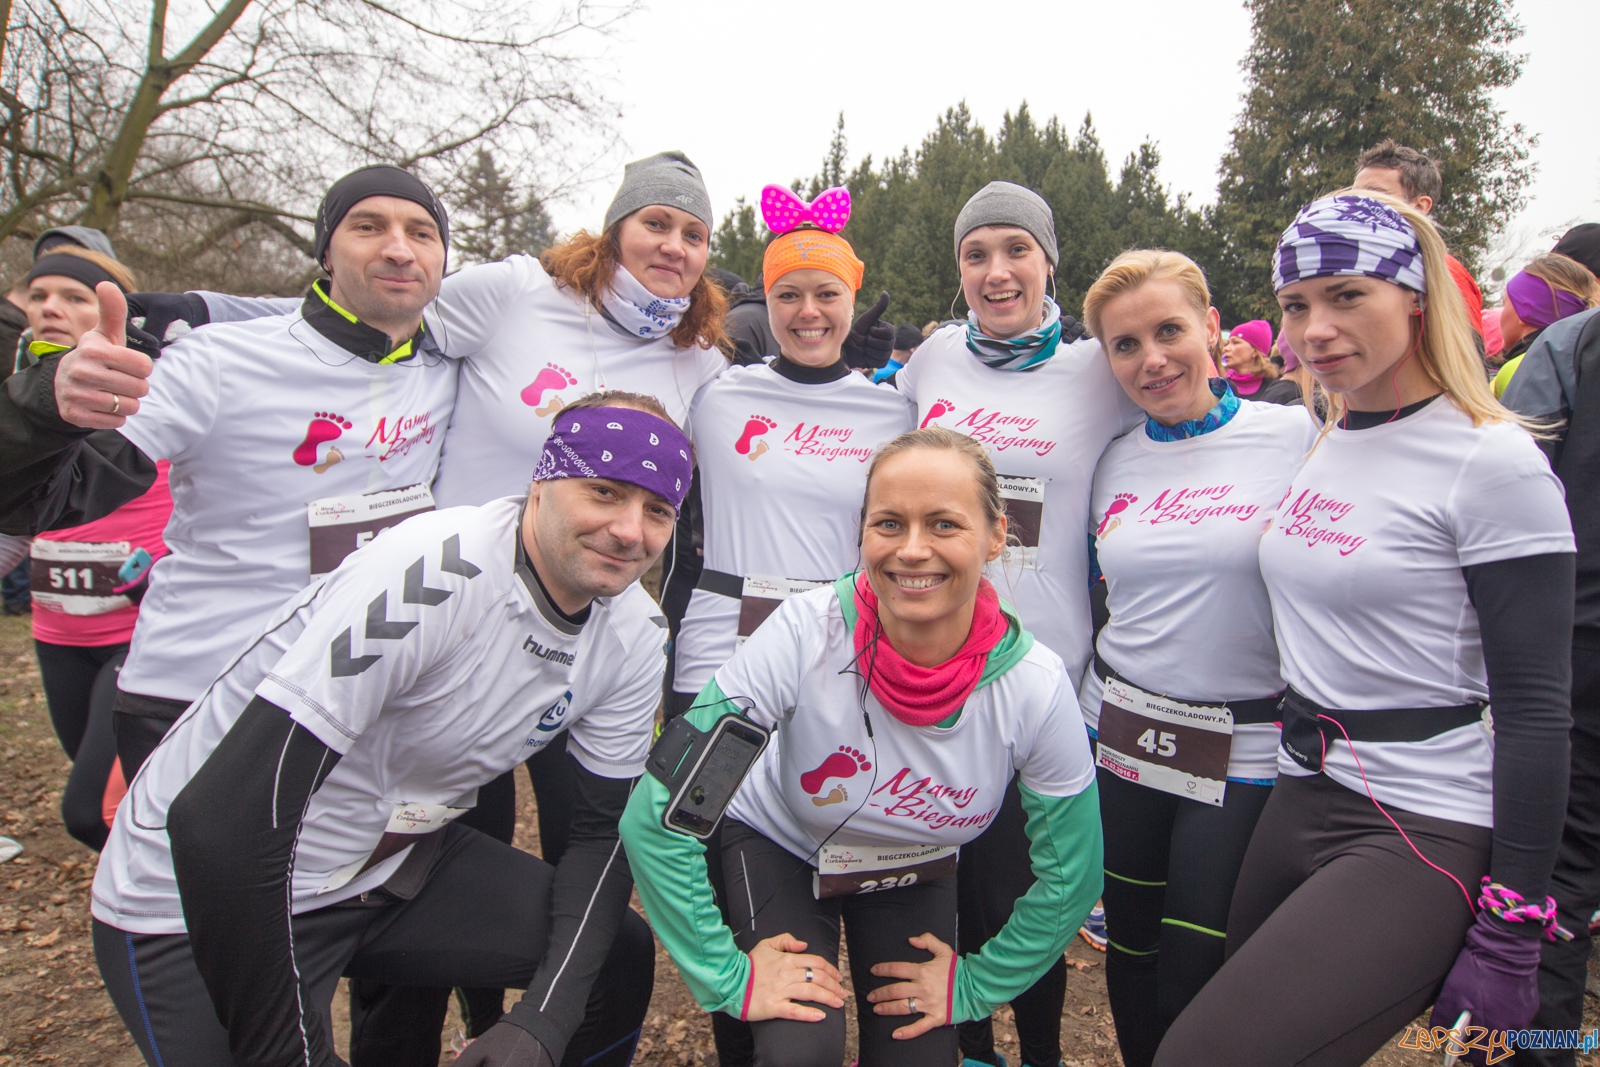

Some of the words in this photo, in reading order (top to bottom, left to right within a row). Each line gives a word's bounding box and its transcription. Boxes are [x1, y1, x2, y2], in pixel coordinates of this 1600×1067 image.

[365, 411, 432, 449] Mamy
[784, 421, 854, 444] Mamy
[955, 407, 1040, 433] Mamy
[378, 423, 437, 463] Biegamy
[794, 439, 874, 464] Biegamy
[968, 425, 1058, 457] Biegamy
[368, 492, 429, 511] BIEGCZEKOLADOWY.PL
[1140, 484, 1235, 516] Mamy
[1149, 503, 1261, 526] Biegamy
[1281, 488, 1356, 523] Mamy
[1285, 514, 1368, 557] Biegamy
[48, 566, 93, 590] 511
[1146, 702, 1228, 725] BIEGCZEKOLADOWY.PL
[1137, 728, 1177, 758] 45
[872, 767, 979, 809] Mamy
[884, 796, 998, 830] Biegamy
[856, 872, 918, 895] 230
